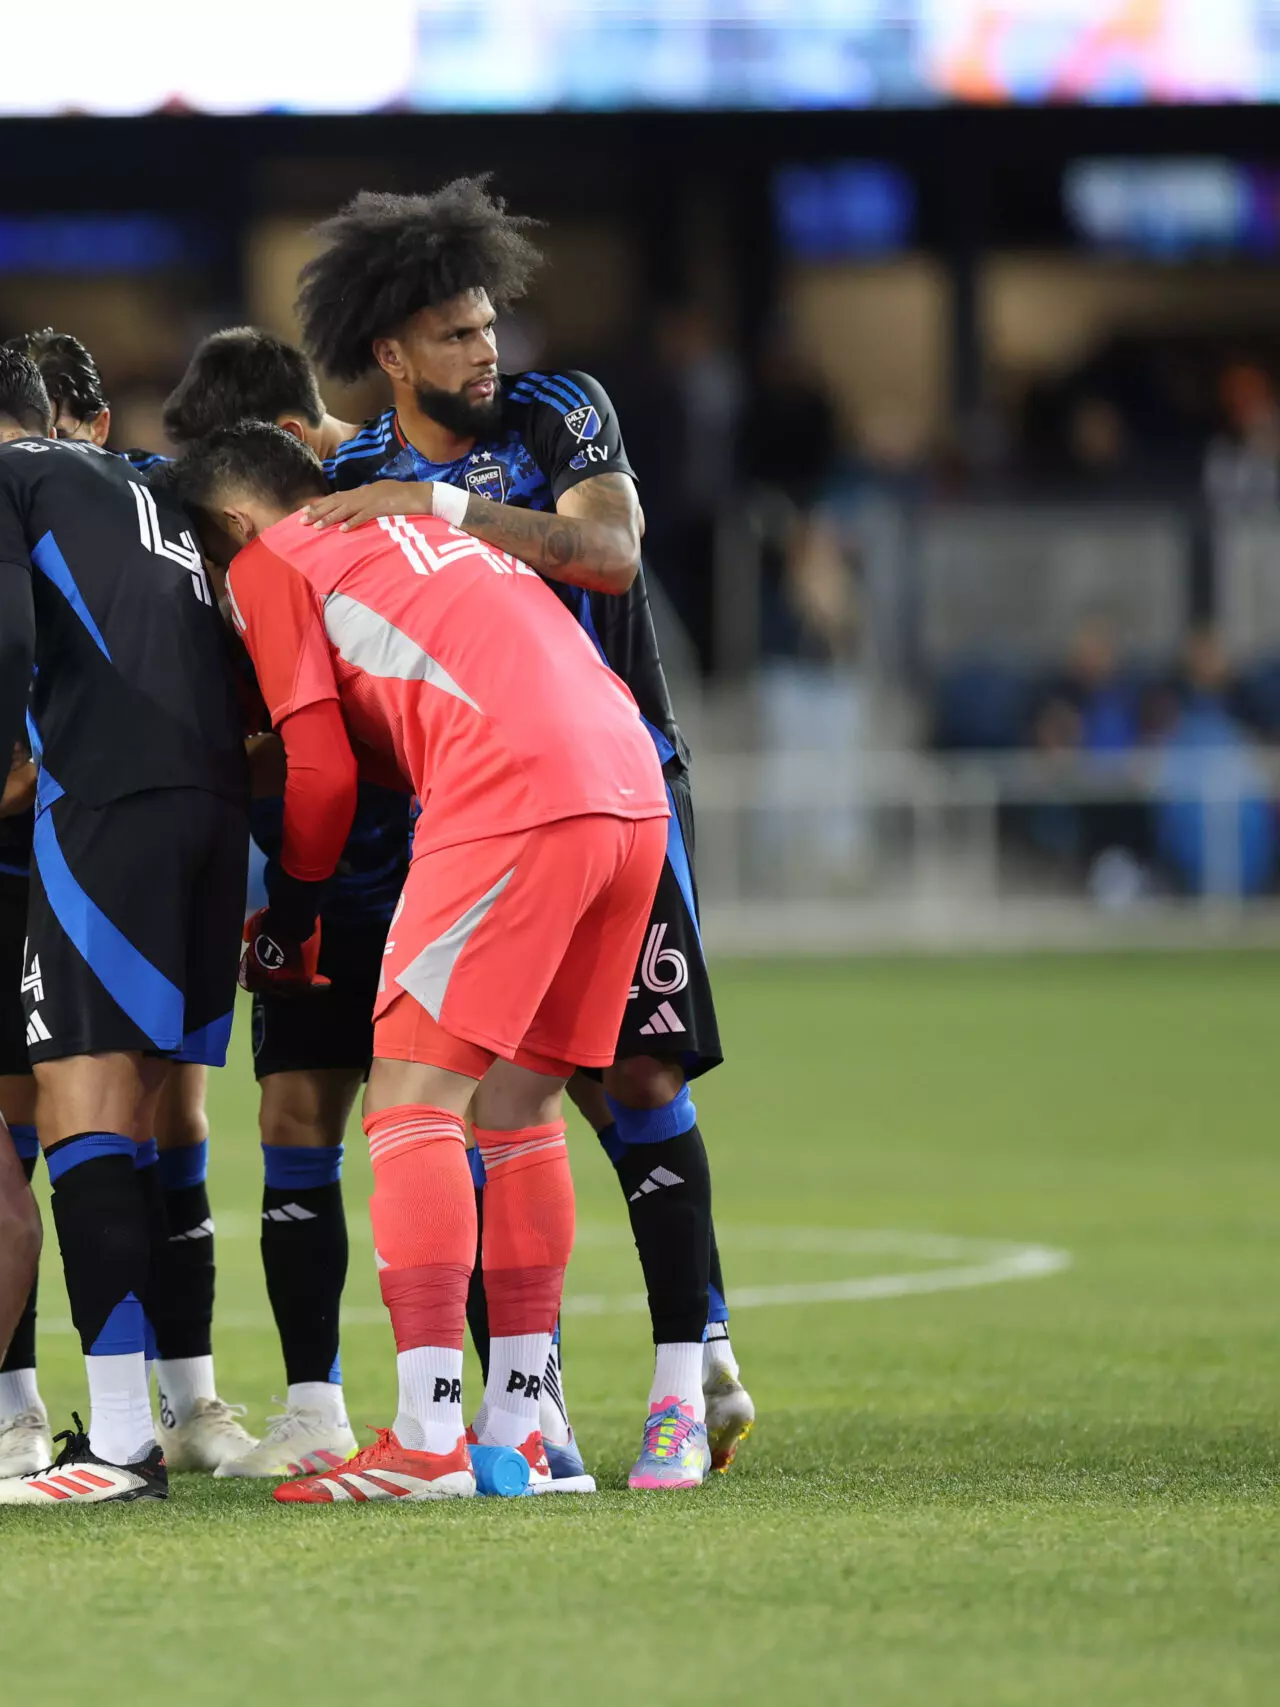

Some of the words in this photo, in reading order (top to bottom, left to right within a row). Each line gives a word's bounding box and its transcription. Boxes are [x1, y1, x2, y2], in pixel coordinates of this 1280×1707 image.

[567, 410, 586, 424] MLS
[586, 443, 609, 463] tv
[468, 470, 499, 484] QUAKES
[127, 479, 213, 608] 4
[376, 515, 542, 578] 4
[627, 922, 689, 1000] 6
